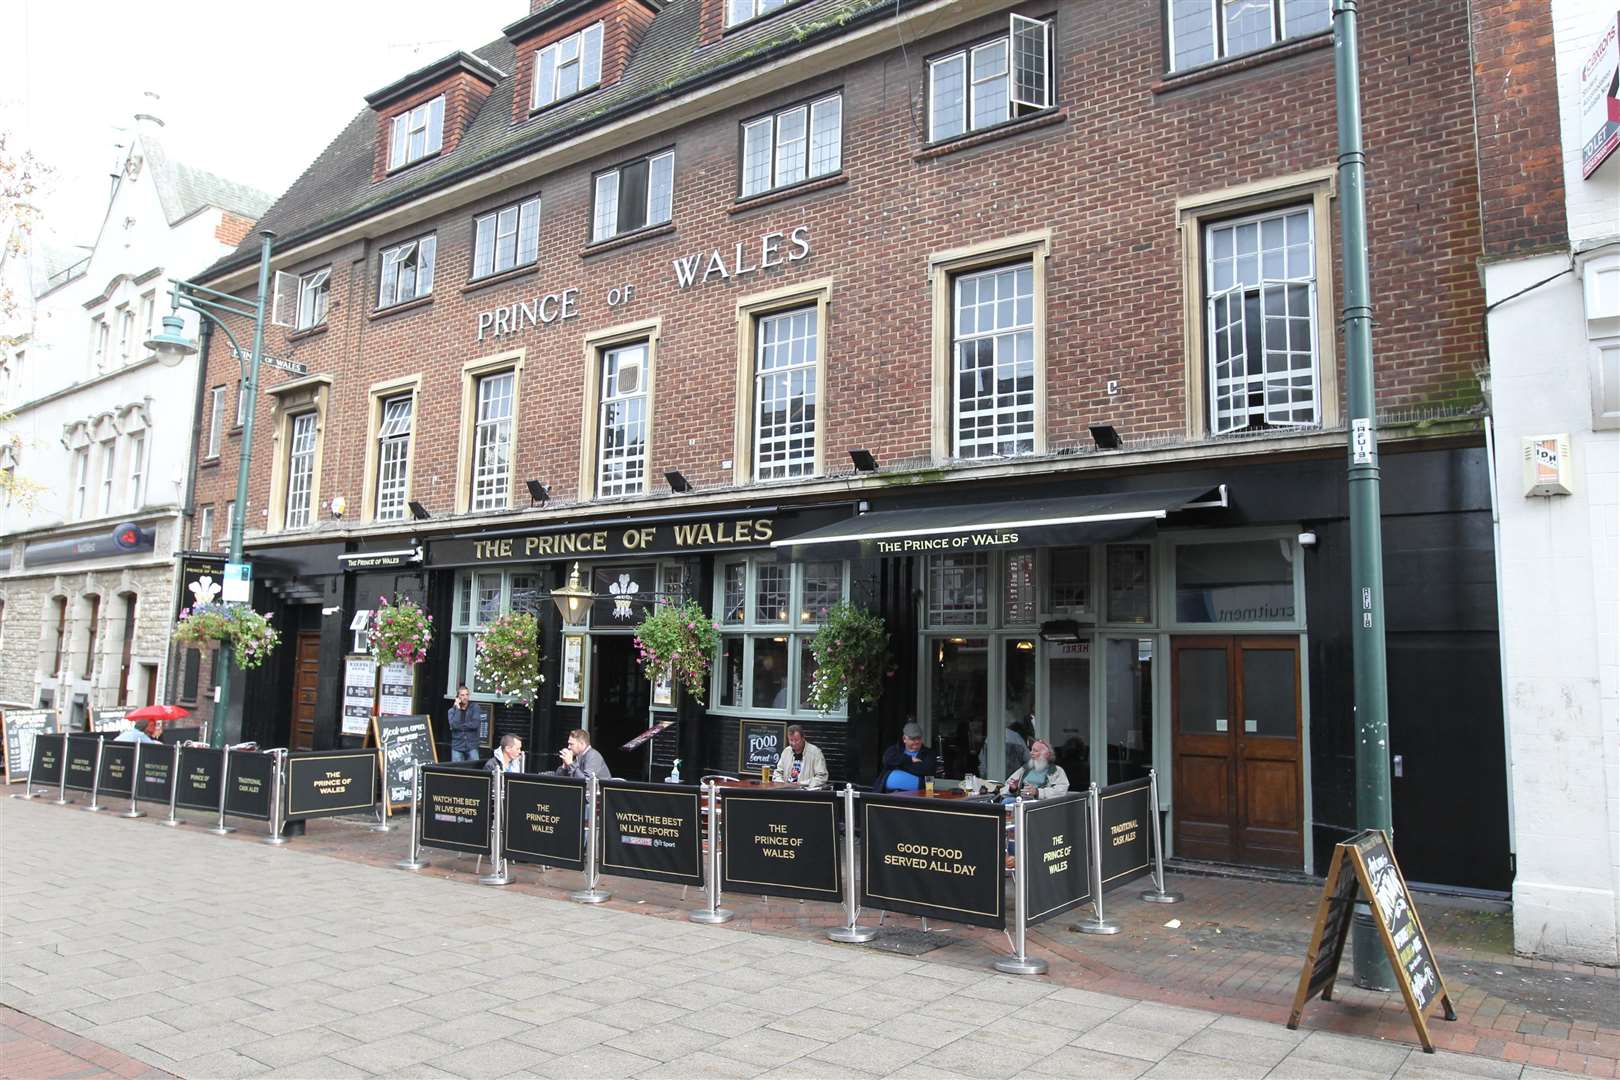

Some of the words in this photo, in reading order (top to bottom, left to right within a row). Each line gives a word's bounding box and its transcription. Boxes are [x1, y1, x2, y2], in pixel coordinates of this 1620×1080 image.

[477, 287, 579, 341] PRINCE
[606, 284, 635, 307] OF
[671, 225, 811, 289] WALES
[276, 359, 301, 371] WALES
[473, 538, 513, 560] THE
[525, 531, 608, 555] PRINCE
[622, 527, 656, 549] OF
[673, 519, 774, 546] WALES
[877, 541, 902, 553] THE
[903, 537, 951, 551] PRINCE
[951, 536, 970, 548] OF
[971, 532, 1019, 546] WALES
[348, 559, 357, 567] THE
[382, 557, 400, 565] WALES
[750, 735, 778, 753] FOOD
[388, 743, 412, 761] PARTY
[320, 786, 346, 795] WALES
[432, 794, 453, 804] WATCH
[453, 797, 464, 805] THE
[465, 798, 480, 807] BEST
[536, 803, 550, 812] THE
[441, 806, 454, 814] LIVE
[454, 807, 478, 816] SPORTS
[526, 813, 550, 823] PRINCE
[550, 816, 560, 824] OF
[615, 812, 643, 822] WATCH
[645, 815, 661, 824] THE
[662, 816, 683, 827] BEST
[531, 823, 554, 834] WALES
[619, 824, 628, 832] IN
[628, 825, 647, 834] LIVE
[647, 827, 679, 838] SPORTS
[769, 824, 787, 833] THE
[1110, 820, 1139, 835] TRADITIONAL
[754, 835, 789, 847] PRINCE
[790, 838, 803, 847] OF
[1052, 834, 1064, 846] THE
[1112, 834, 1125, 847] CASK
[1125, 831, 1136, 843] ALES
[762, 848, 795, 859] WALES
[897, 843, 929, 856] GOOD
[931, 846, 962, 860] FOOD
[1043, 847, 1064, 863] PRINCE
[1064, 845, 1072, 857] OF
[884, 855, 927, 870] SERVED
[929, 860, 953, 874] ALL
[954, 864, 976, 876] DAY
[1048, 861, 1068, 875] WALES
